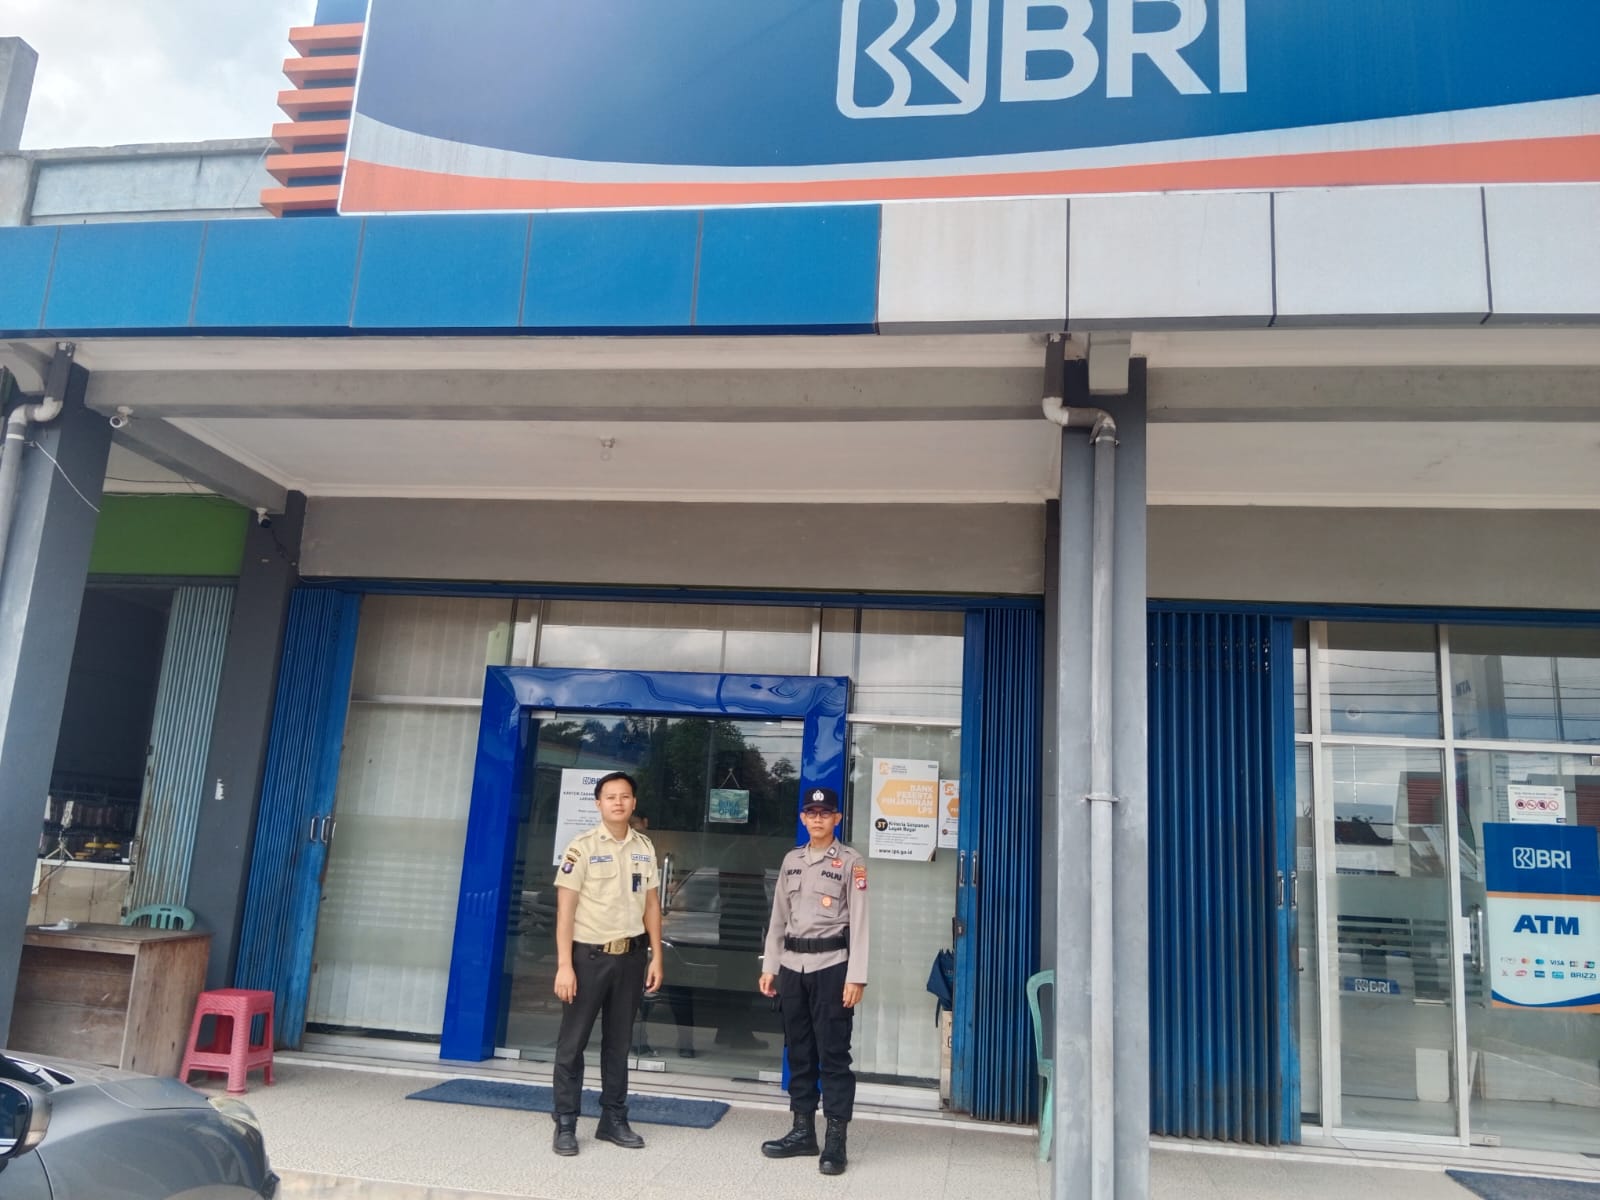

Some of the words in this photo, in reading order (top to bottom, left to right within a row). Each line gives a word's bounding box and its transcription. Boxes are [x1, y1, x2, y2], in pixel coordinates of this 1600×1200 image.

[1000, 0, 1248, 102] BRI
[910, 784, 934, 793] BANK
[1536, 850, 1571, 869] BRI
[821, 870, 842, 881] POLRI
[1513, 914, 1580, 936] ATM
[1570, 971, 1597, 980] BRIZZI
[1369, 980, 1390, 993] BRI
